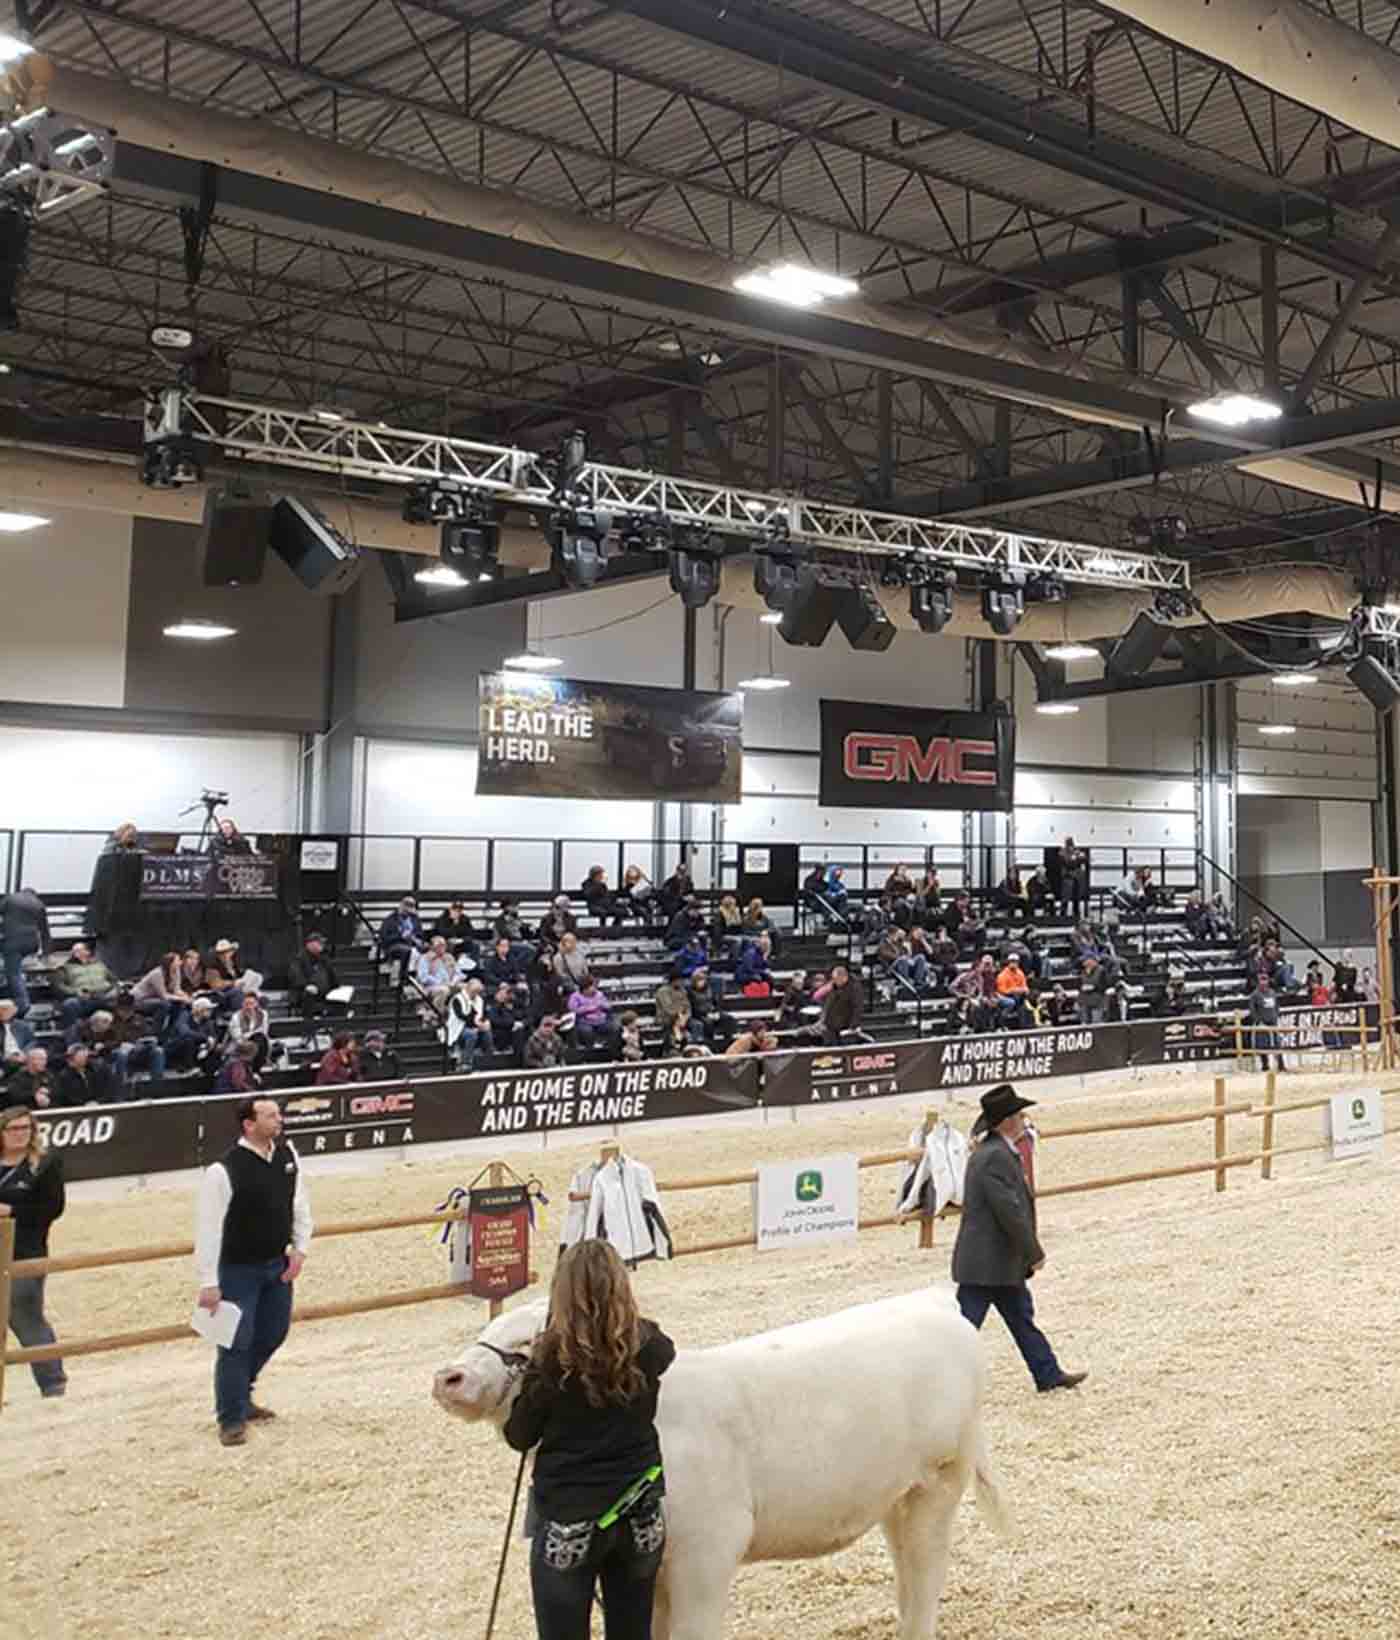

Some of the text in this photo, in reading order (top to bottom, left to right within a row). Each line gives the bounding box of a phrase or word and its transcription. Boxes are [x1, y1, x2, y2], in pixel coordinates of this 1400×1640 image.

[488, 707, 594, 738] LEAD THE
[487, 736, 556, 763] HERD.
[844, 731, 997, 785] GMC
[853, 1054, 896, 1071] GMC
[942, 1031, 1093, 1064] AT HOME ON THE ROAD
[942, 1056, 1054, 1085] AND THE RANGE
[481, 1066, 707, 1106] AT HOME ON THE ROAD
[351, 1093, 415, 1115] GMC
[481, 1095, 646, 1132] AND THE RANGE
[38, 1116, 114, 1148] ROAD
[314, 1127, 414, 1151] RENA
[761, 1218, 855, 1238] Profile of Champions
